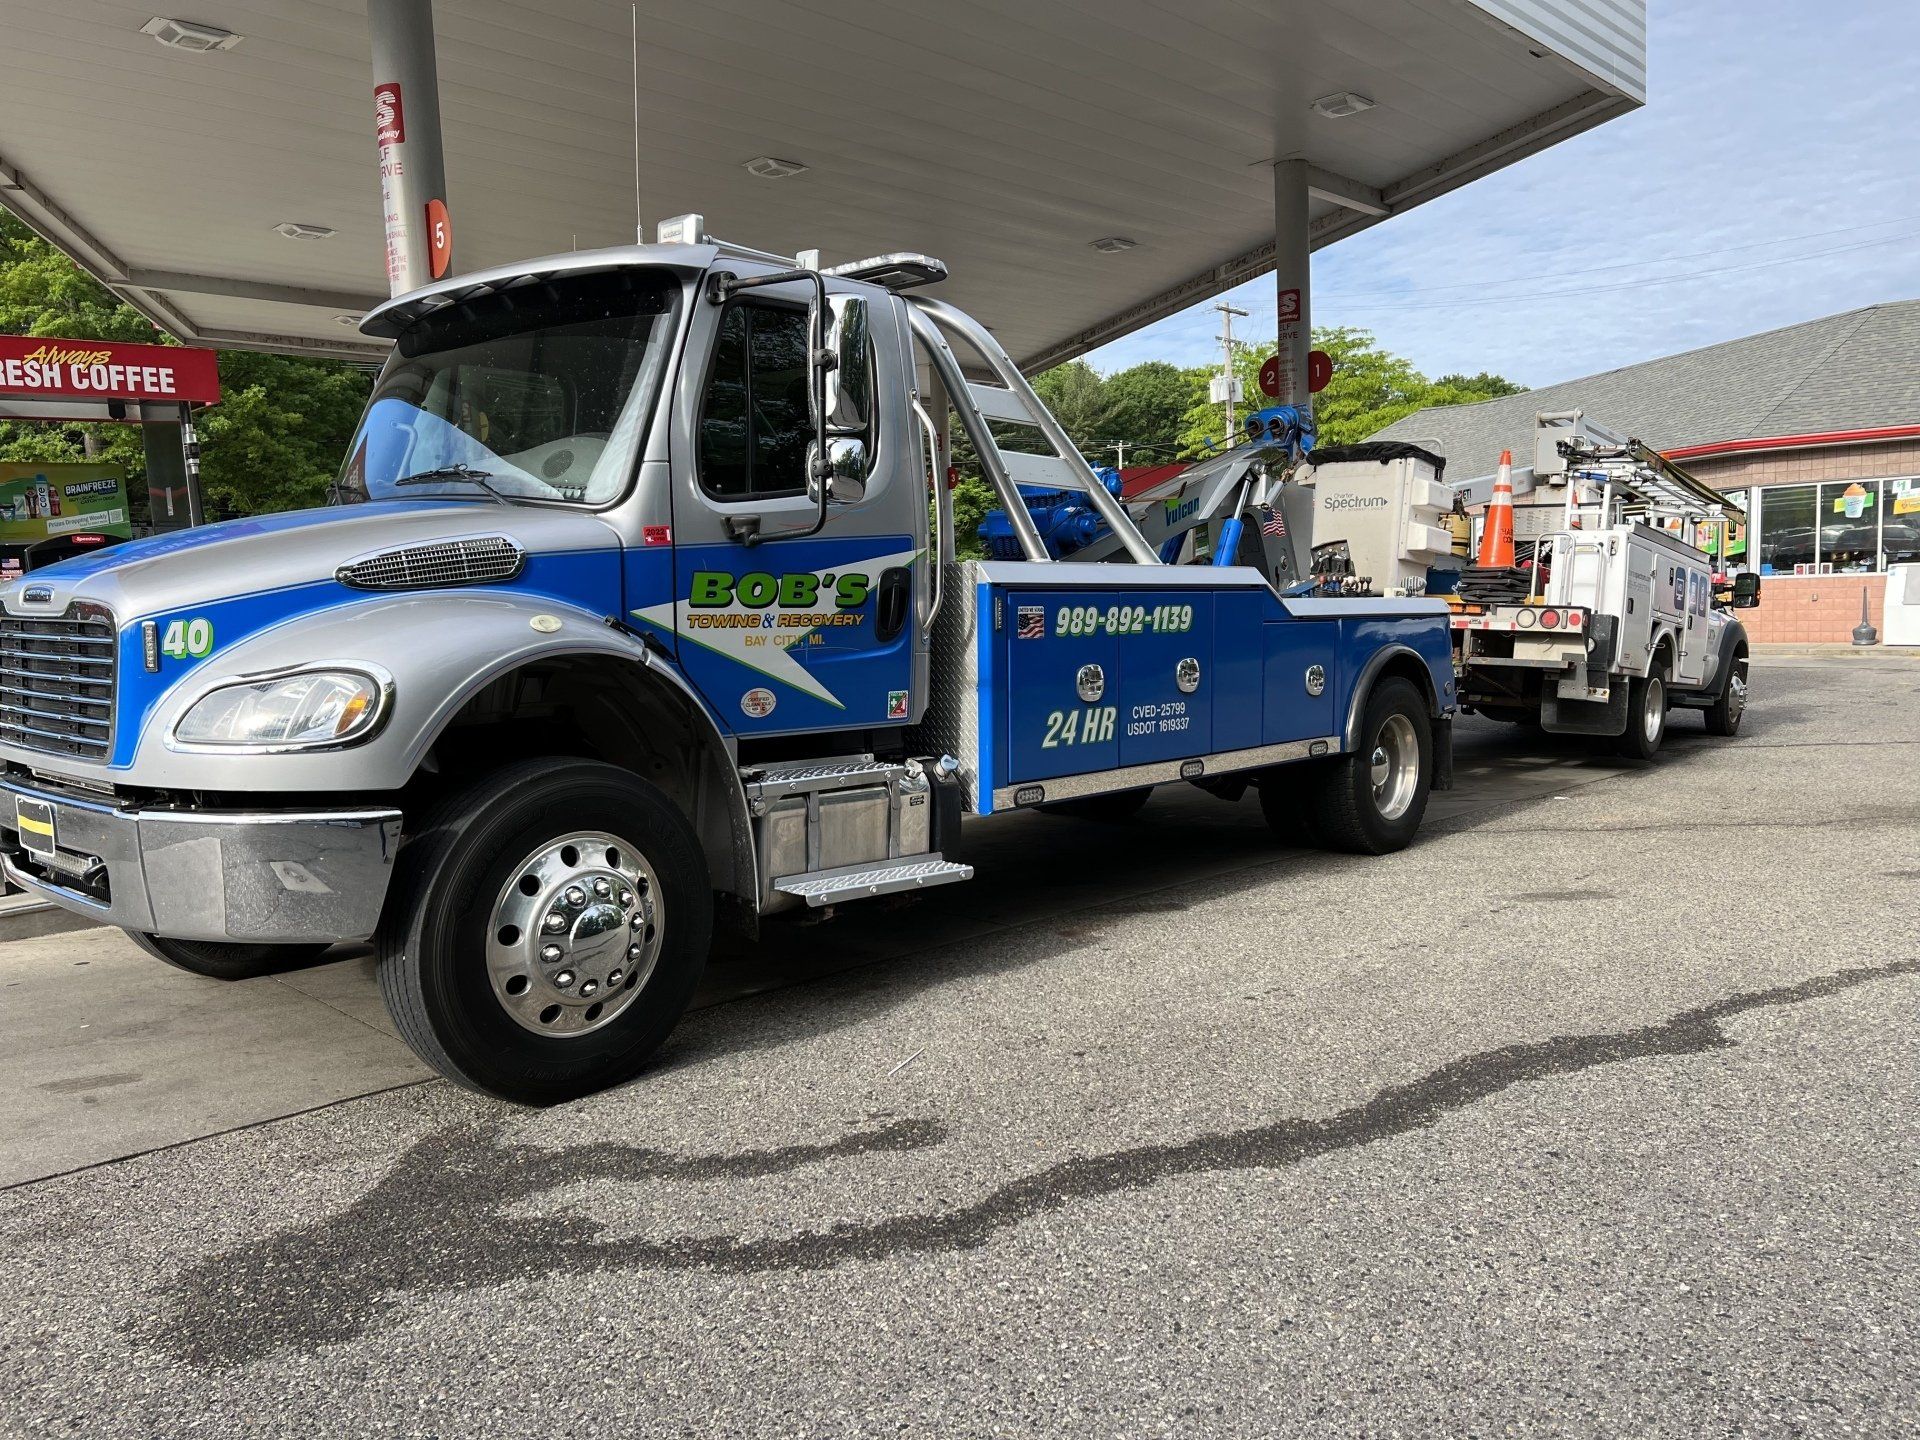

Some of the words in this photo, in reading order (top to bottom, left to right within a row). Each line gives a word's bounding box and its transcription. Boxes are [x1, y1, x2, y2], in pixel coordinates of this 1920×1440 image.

[436, 221, 445, 249] 5
[22, 345, 112, 370] Always
[70, 362, 176, 394] COFFEE
[1266, 370, 1275, 385] 2
[1315, 363, 1320, 378] 1
[65, 479, 117, 496] BRAINFREEZE
[1324, 496, 1384, 512] Spectrum
[646, 528, 665, 536] 2022
[689, 571, 869, 609] BOB'S
[687, 613, 761, 629] TOWING
[762, 613, 775, 629] &
[777, 613, 864, 628] RECOVERY
[1055, 606, 1193, 637] 989-892-1139
[163, 619, 213, 659] 40
[744, 635, 767, 647] BAY
[773, 635, 804, 647] CITY,
[809, 634, 826, 645] MI.
[1132, 702, 1186, 719] CVED-25799
[1042, 710, 1079, 748] 24
[1081, 706, 1117, 743] HR
[1127, 721, 1157, 736] USDOT
[1159, 717, 1190, 732] 1619337
